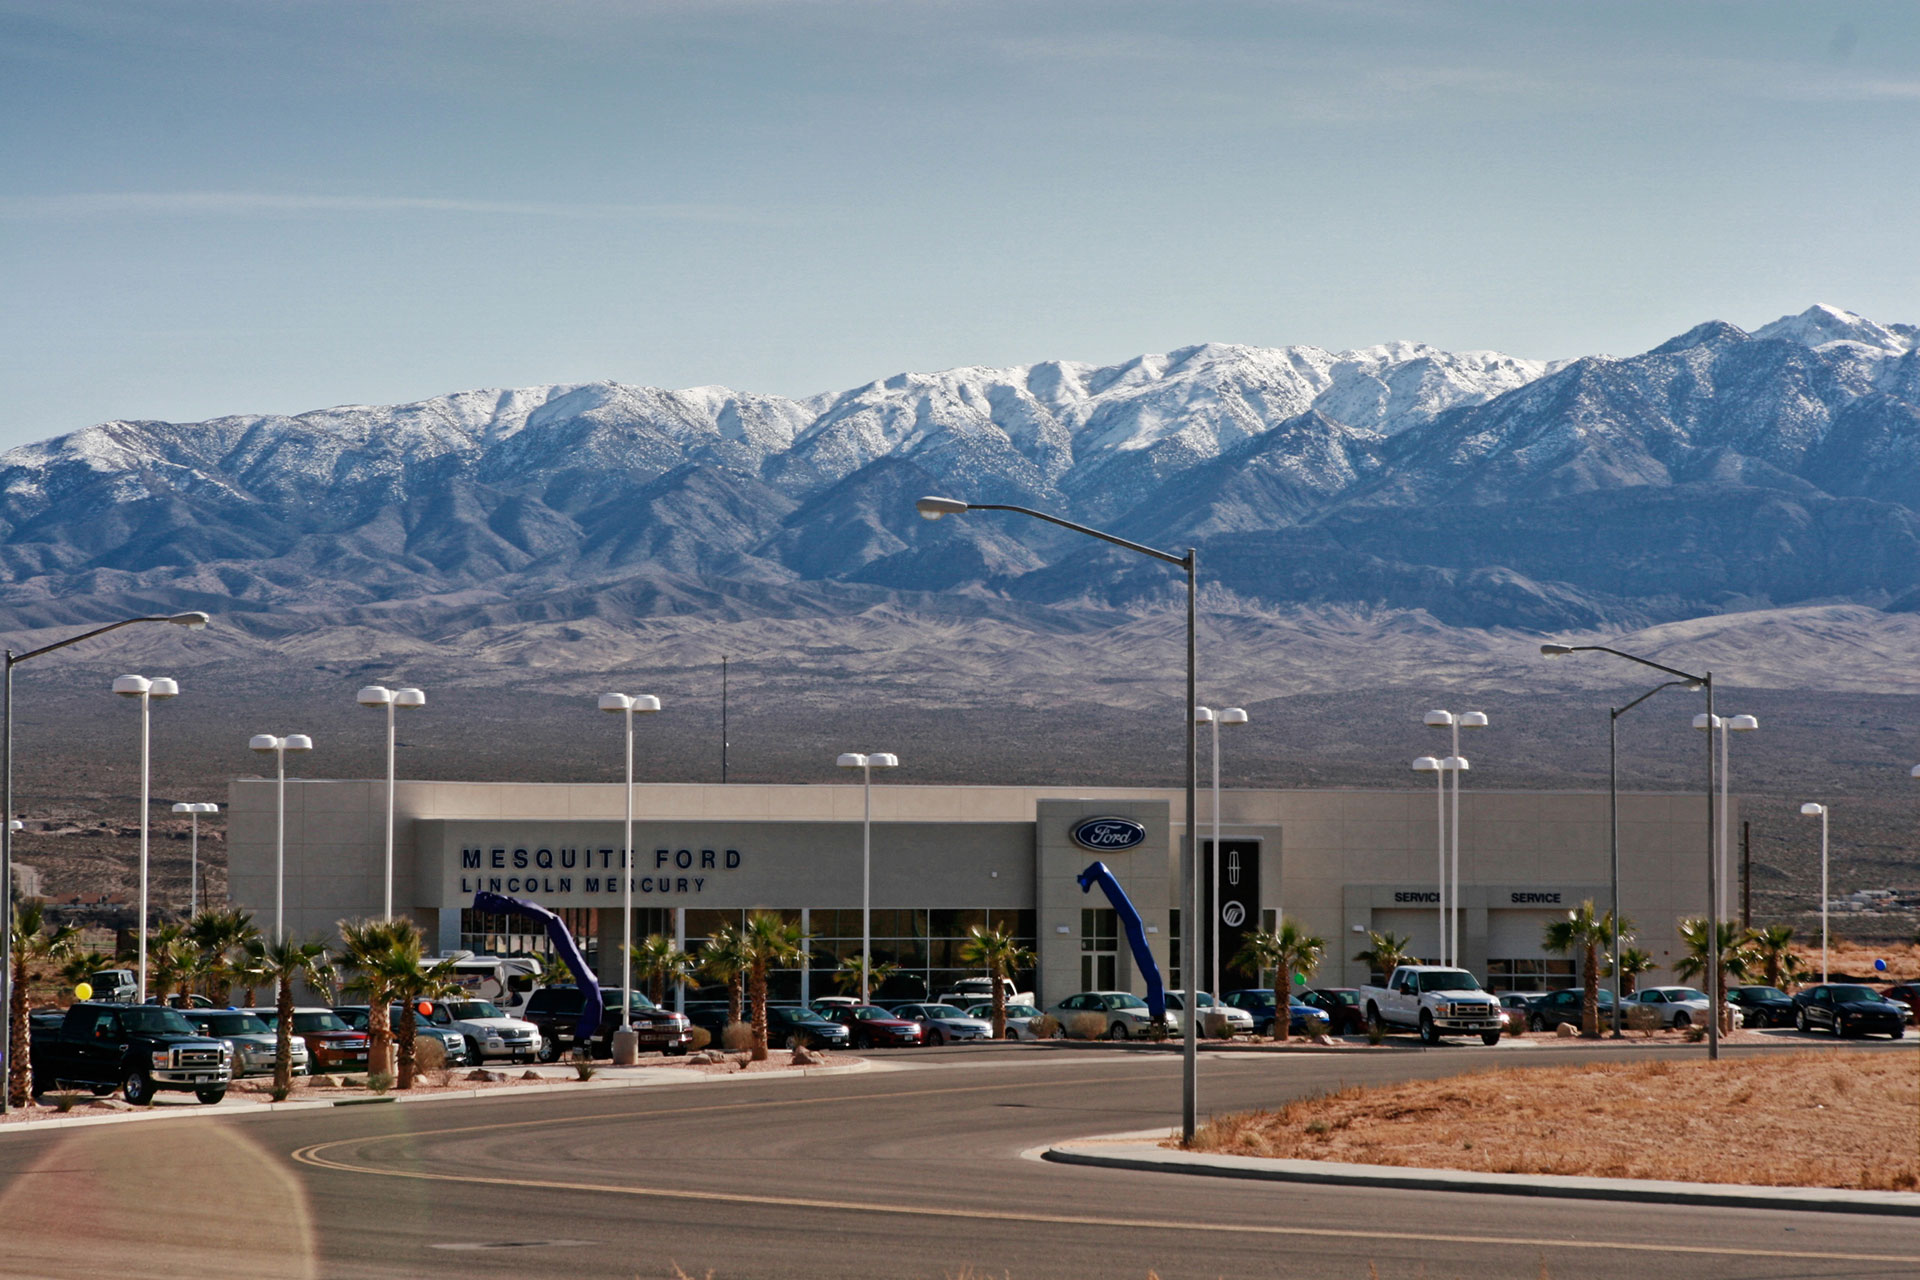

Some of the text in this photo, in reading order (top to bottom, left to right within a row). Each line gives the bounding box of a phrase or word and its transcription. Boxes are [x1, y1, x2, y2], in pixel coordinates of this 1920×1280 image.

[1090, 824, 1132, 844] Ford
[462, 849, 741, 869] MESQUITE FORD
[462, 878, 571, 893] LINCOLN
[1511, 892, 1561, 904] SERVICE
